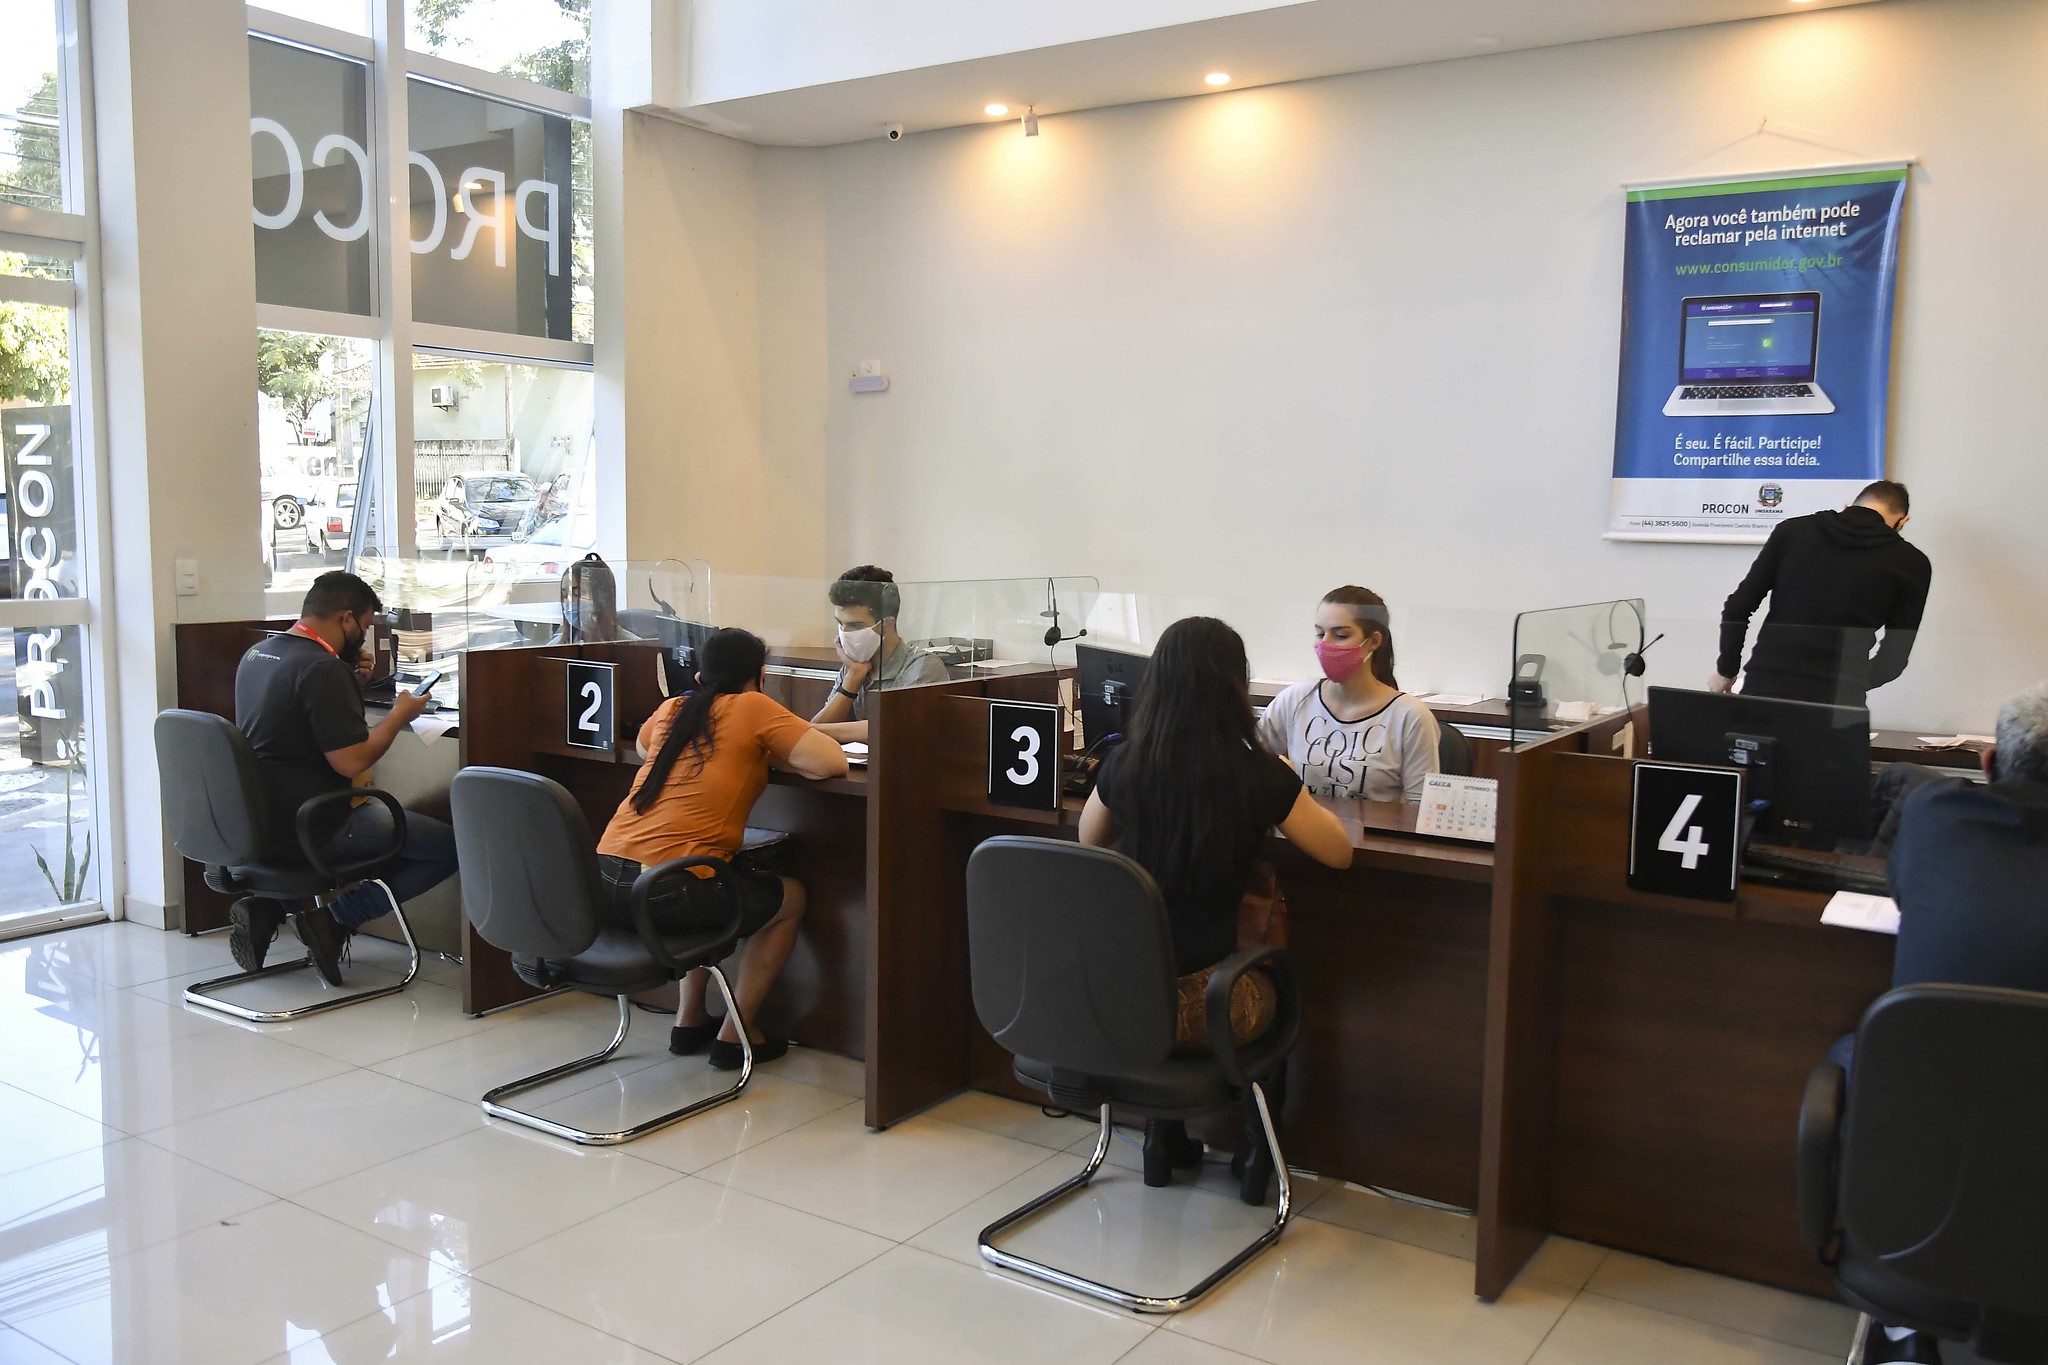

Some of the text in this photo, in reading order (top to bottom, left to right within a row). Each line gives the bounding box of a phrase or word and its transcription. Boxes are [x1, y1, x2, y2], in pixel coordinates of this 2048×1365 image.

[1664, 201, 1860, 233] Agora você também pode
[1675, 222, 1847, 247] reclamar pela internet
[1675, 253, 1843, 275] www.consumidor.gov.br
[1674, 432, 1822, 453] É seu. É fácil. Participe!
[1673, 453, 1820, 469] Compartilhe essa ideia.
[1702, 503, 1749, 514] PROCON
[578, 681, 602, 732] 2
[1006, 725, 1041, 786] 3
[1657, 794, 1710, 869] 4
